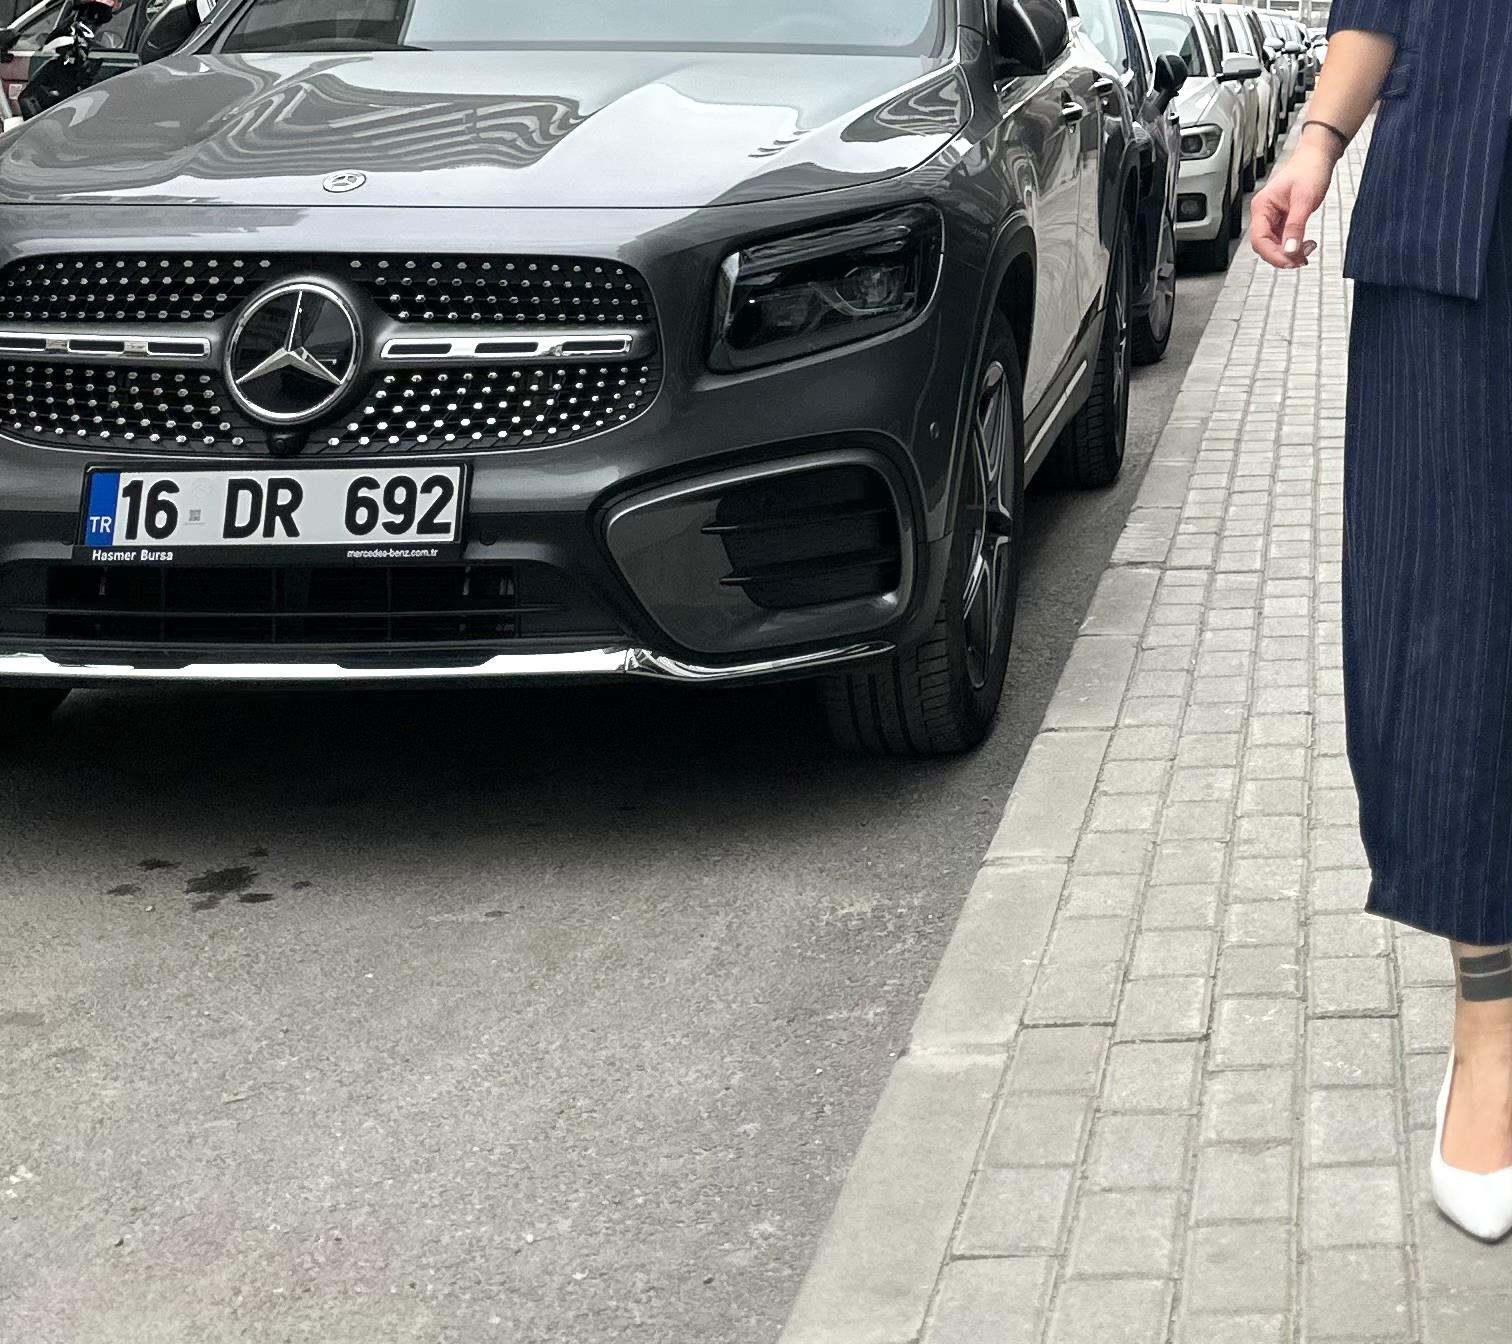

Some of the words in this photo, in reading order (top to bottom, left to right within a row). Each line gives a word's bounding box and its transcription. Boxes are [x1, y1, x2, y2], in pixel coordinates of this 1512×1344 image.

[122, 479, 180, 540] 16
[222, 477, 303, 538] DR
[344, 474, 454, 535] 692
[89, 516, 112, 534] TR
[92, 549, 137, 562] Hasmer
[141, 549, 173, 562] Bursa
